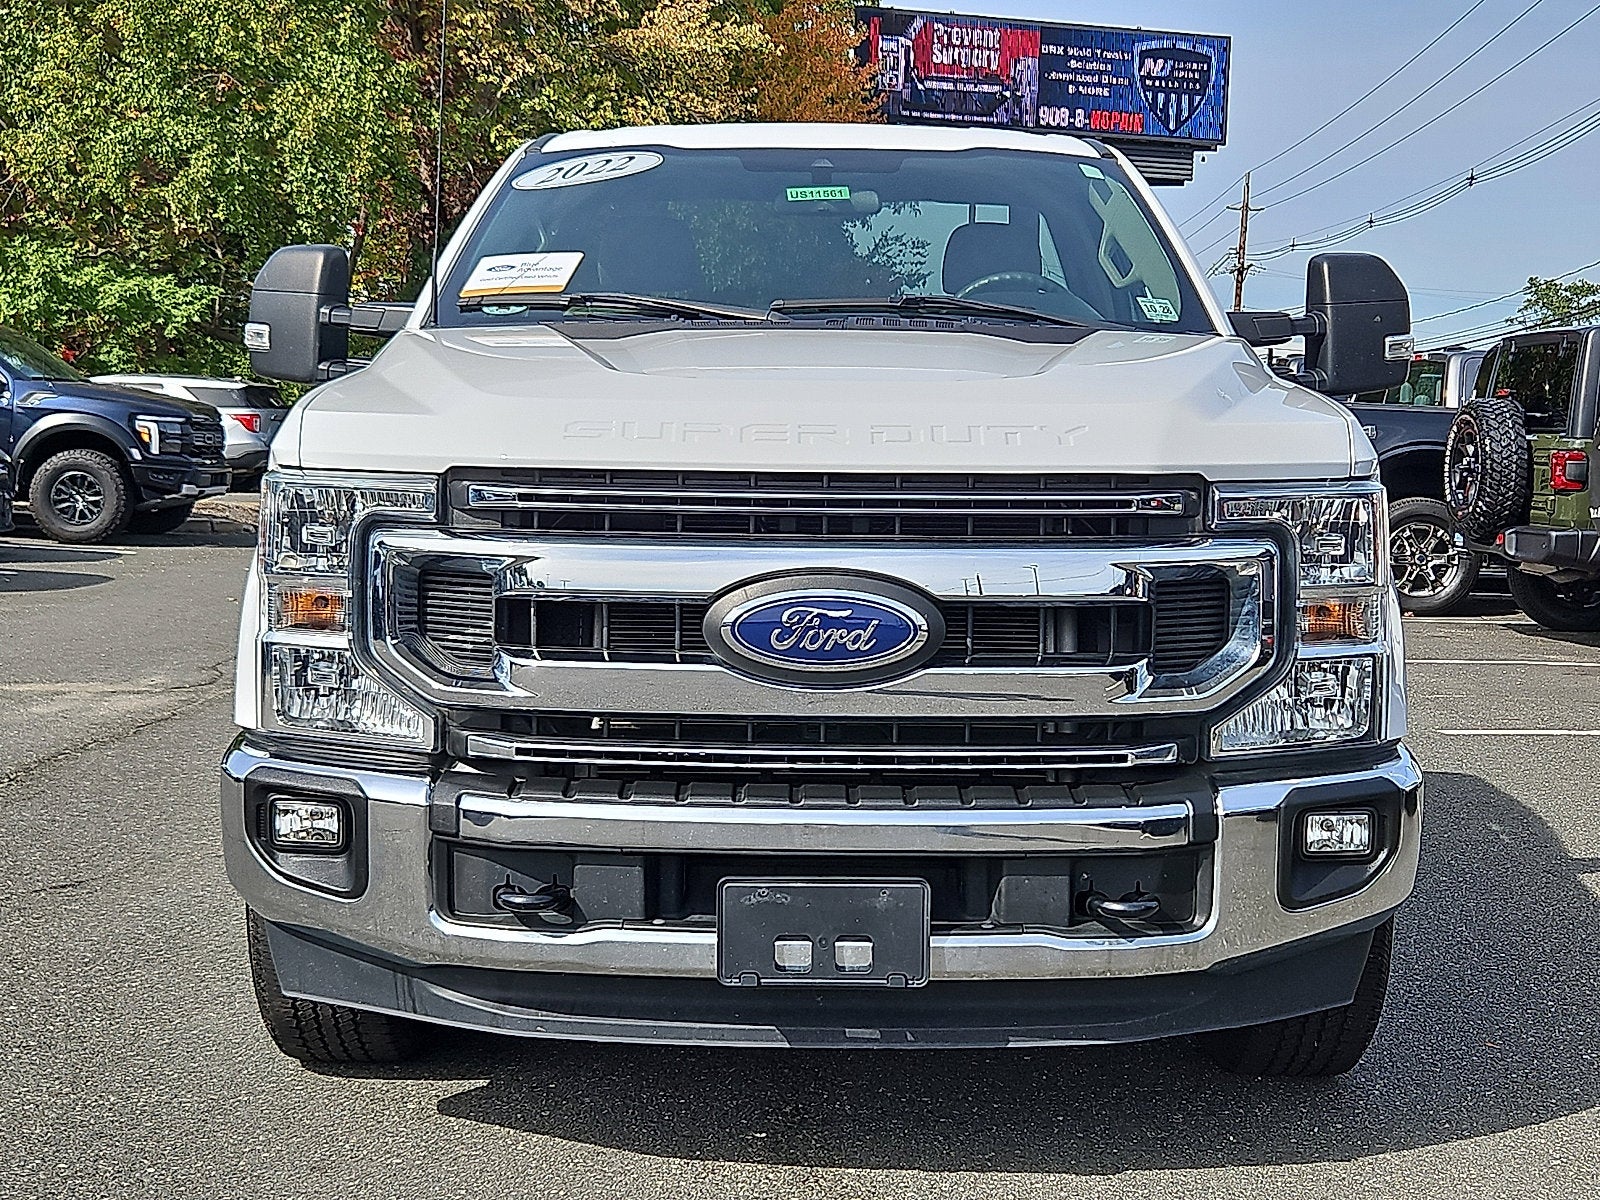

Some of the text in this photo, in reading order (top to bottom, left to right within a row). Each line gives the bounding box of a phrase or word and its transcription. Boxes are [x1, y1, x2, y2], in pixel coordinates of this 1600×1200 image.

[534, 156, 636, 185] 2022
[563, 420, 1088, 447] SUPER DUTY
[770, 606, 881, 651] Ford
